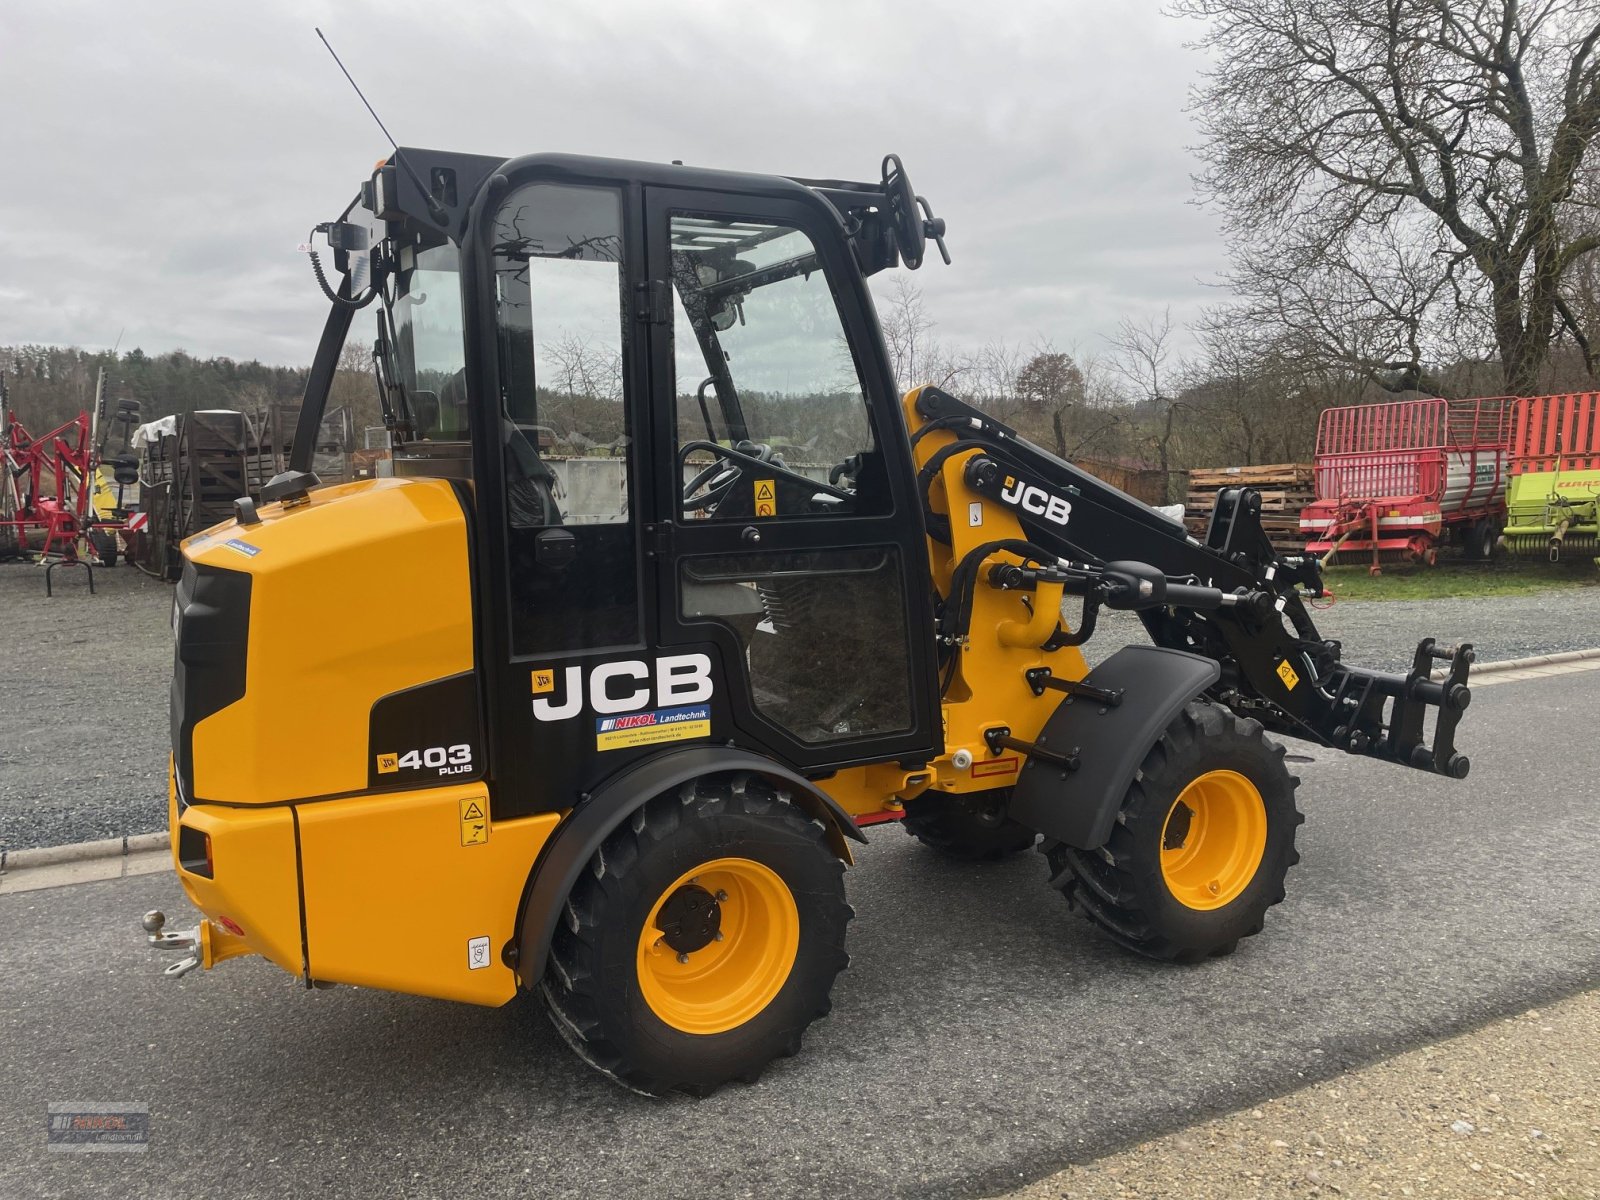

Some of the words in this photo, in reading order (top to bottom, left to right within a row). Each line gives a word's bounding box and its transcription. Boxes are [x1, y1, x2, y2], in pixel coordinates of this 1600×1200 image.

[1001, 480, 1072, 526] JCB
[532, 653, 714, 722] JCB
[614, 713, 657, 730] NIKOL
[660, 710, 707, 723] Landtechnik
[398, 744, 472, 770] 403
[439, 764, 473, 776] PLUS
